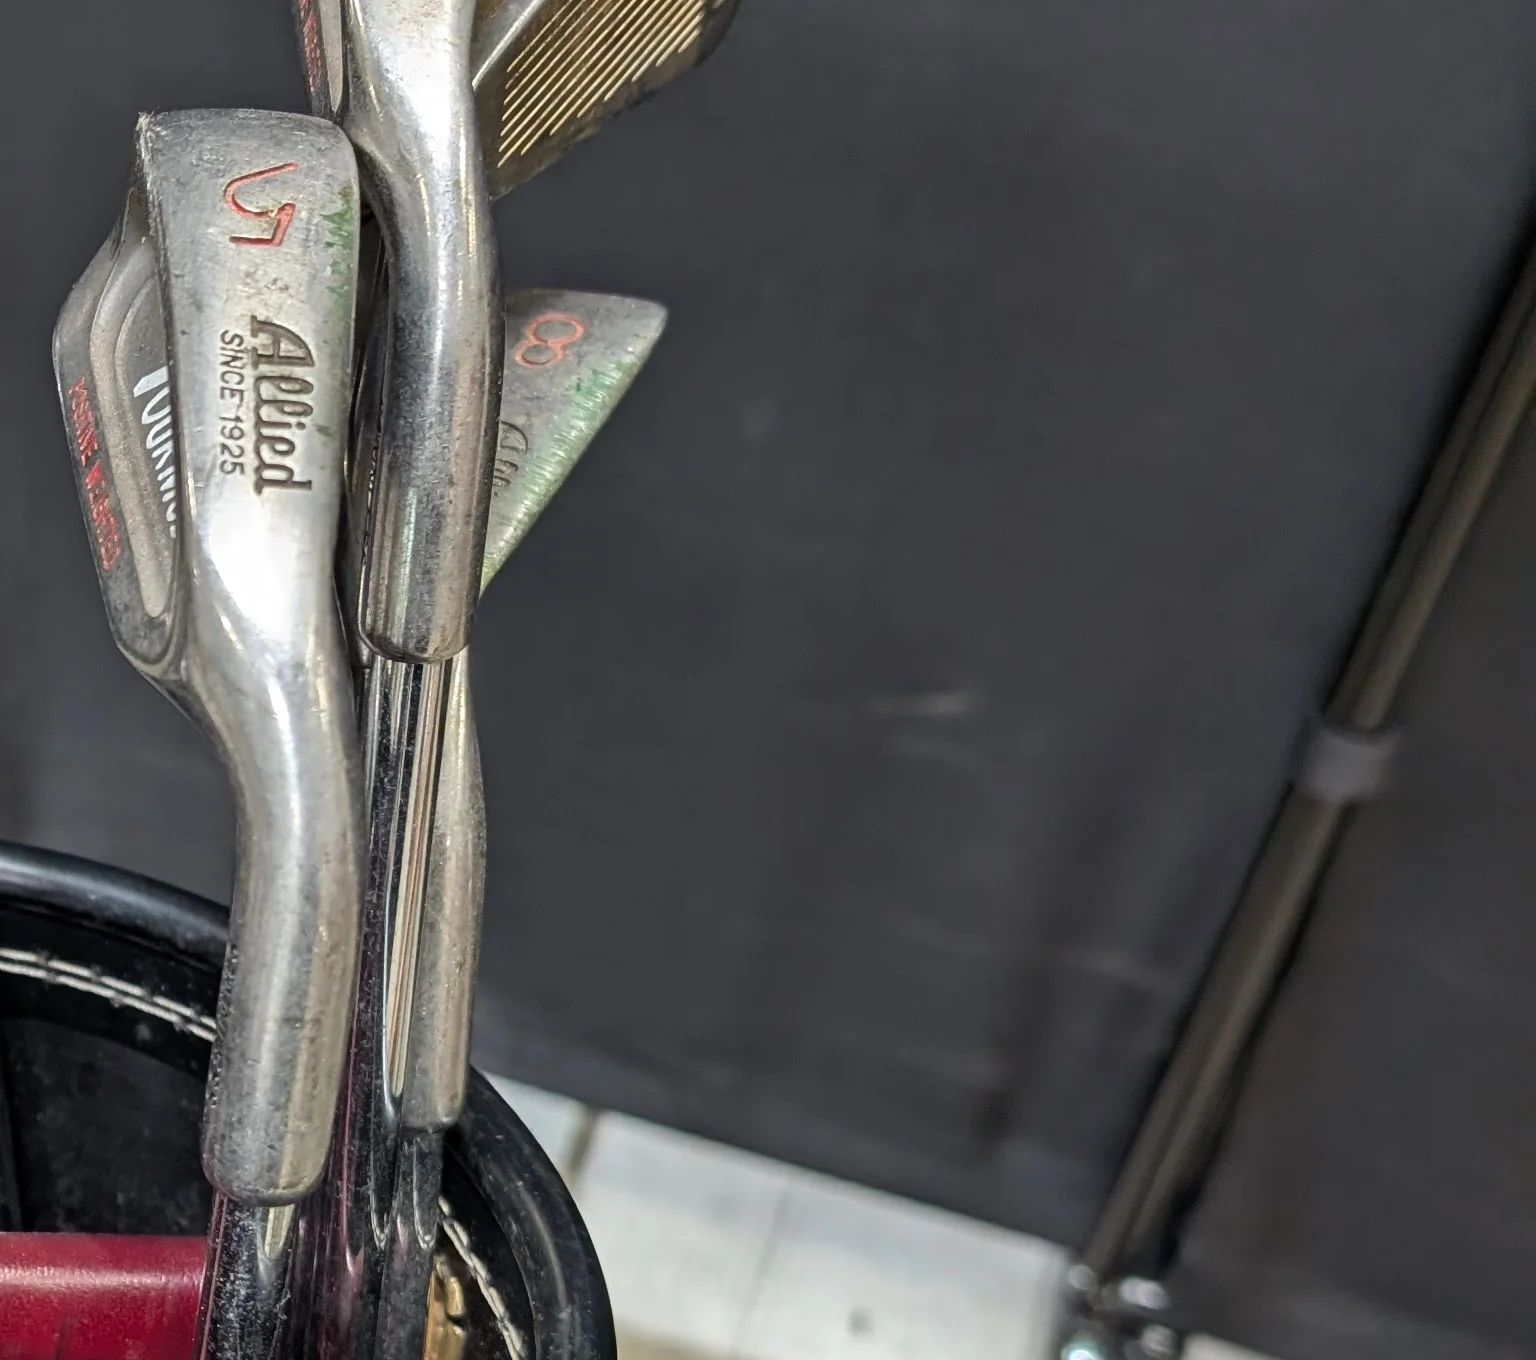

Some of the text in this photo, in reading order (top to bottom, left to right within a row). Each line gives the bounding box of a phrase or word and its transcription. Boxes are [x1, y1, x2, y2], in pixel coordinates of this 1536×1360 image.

[223, 161, 299, 249] 5
[514, 311, 586, 368] 8
[216, 329, 251, 477] SINCE 1925
[246, 313, 316, 495] Allied
